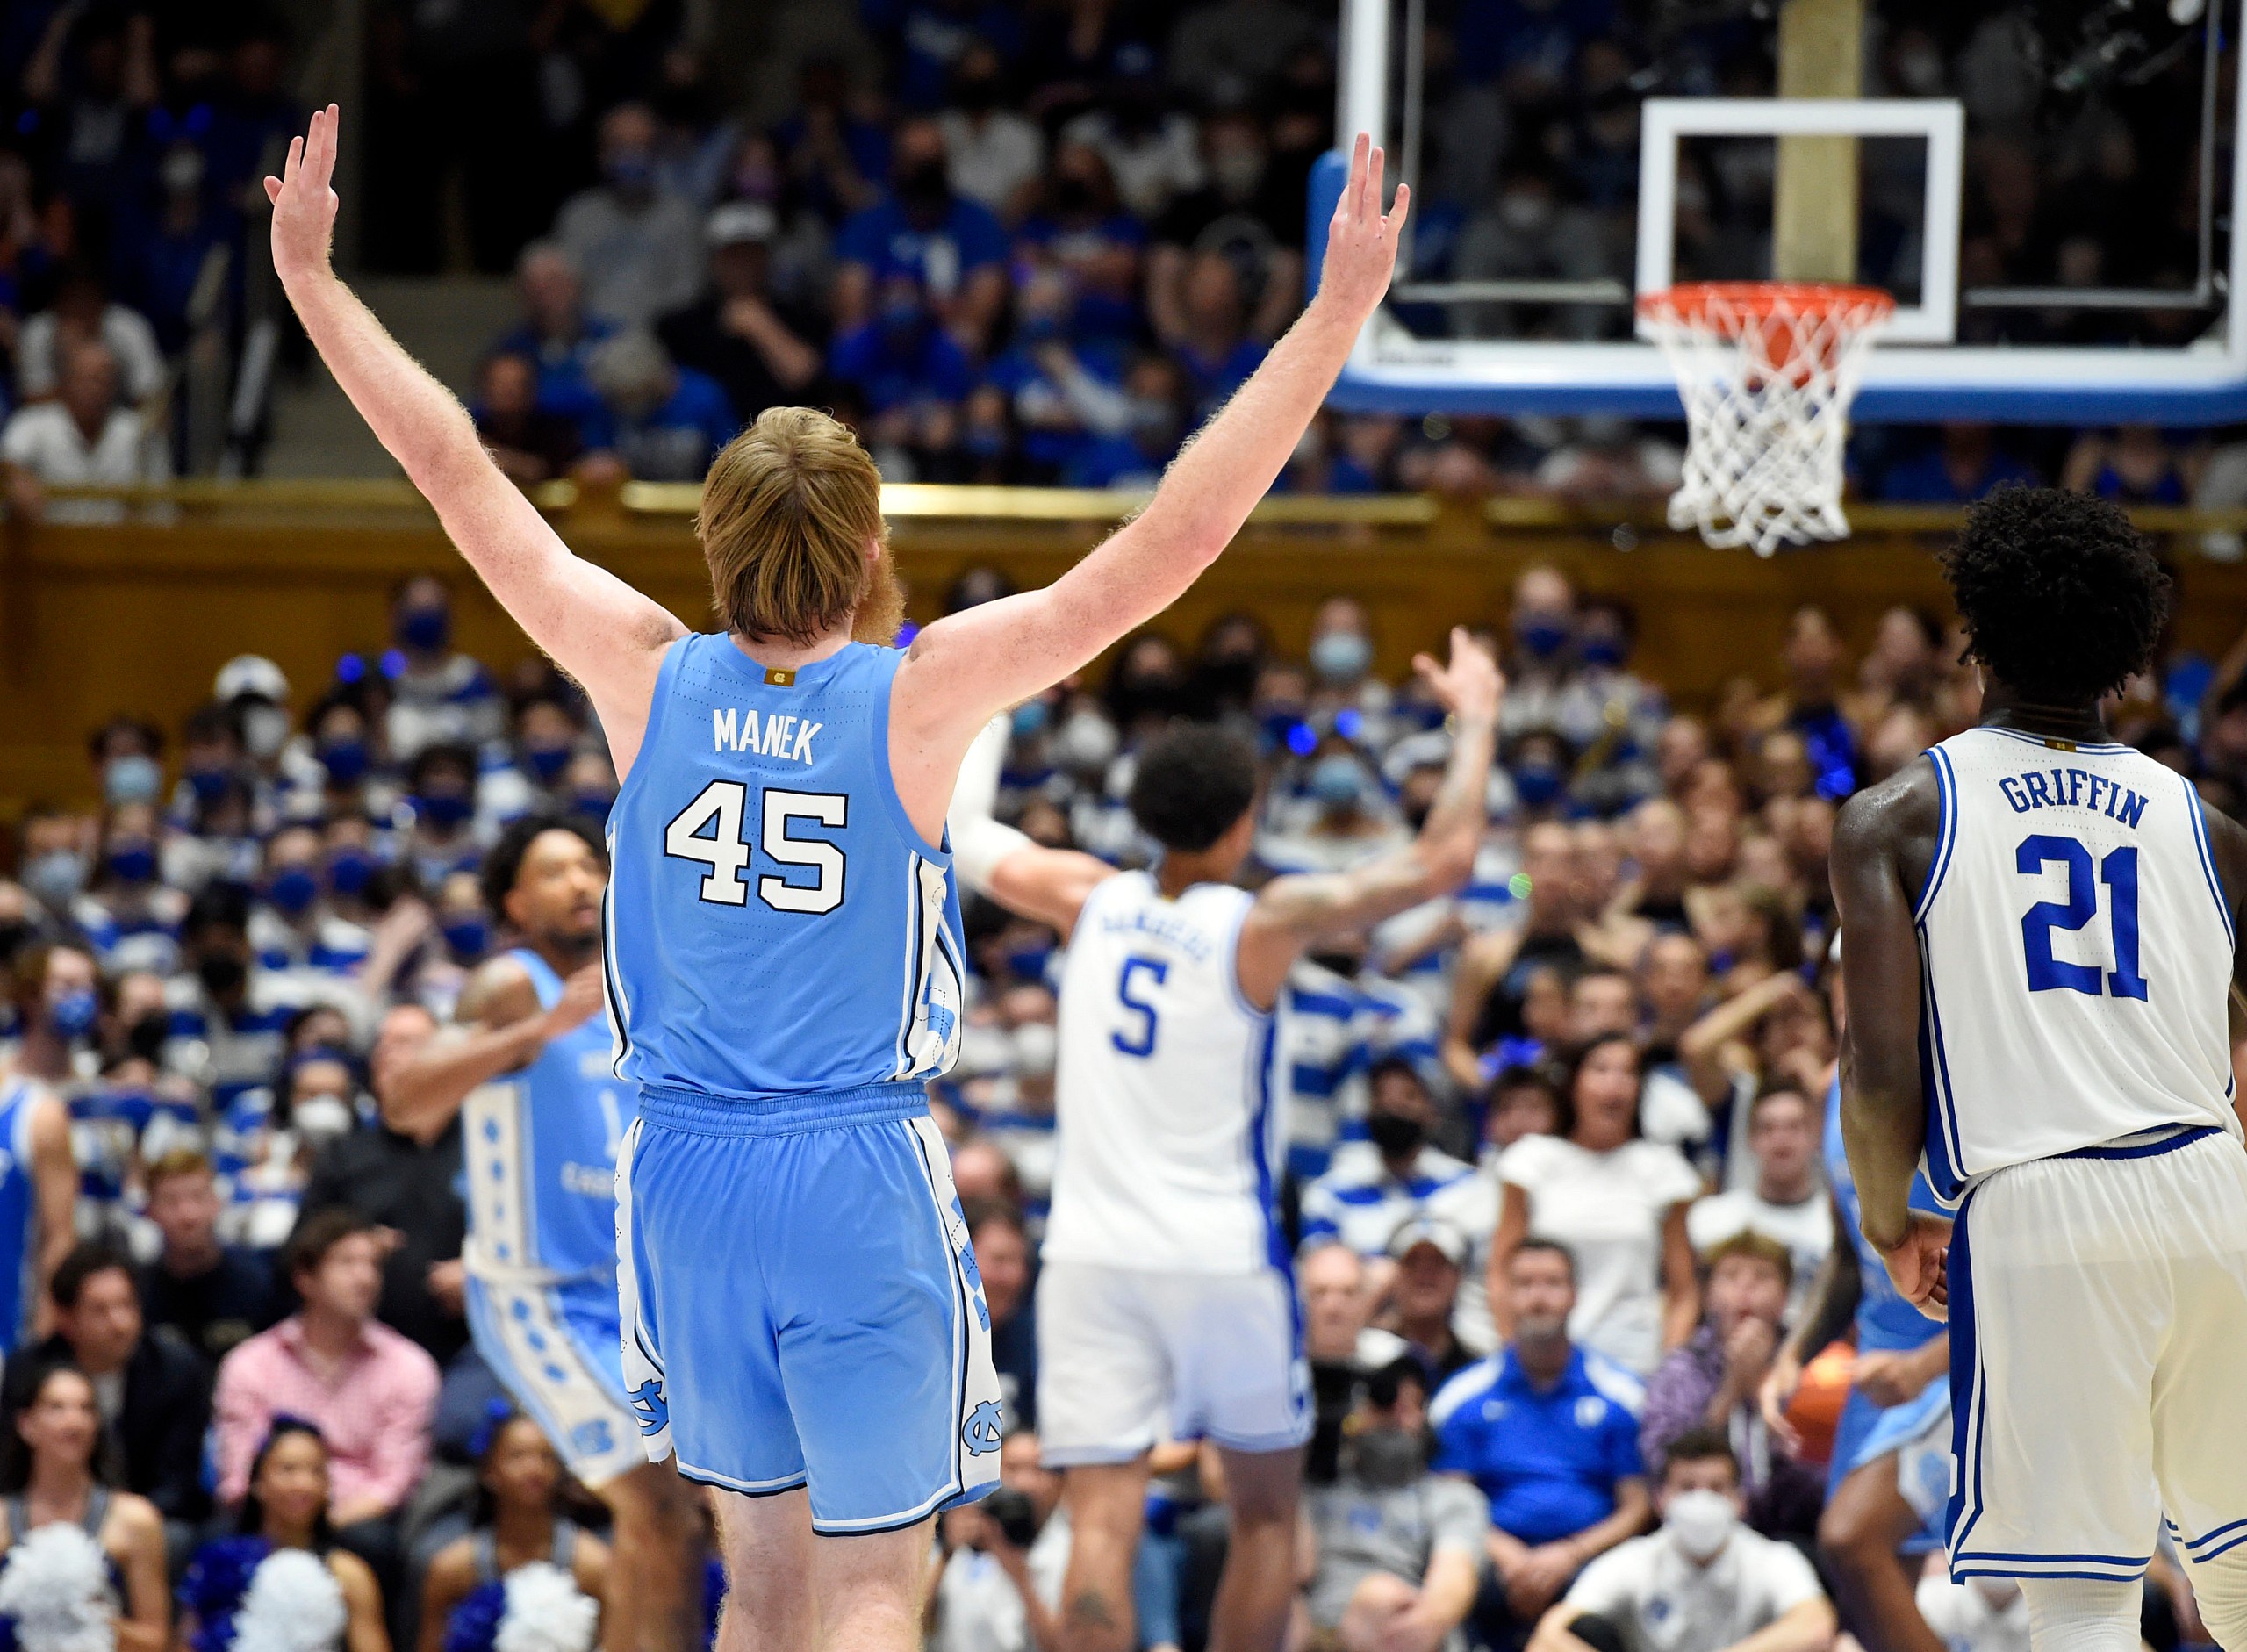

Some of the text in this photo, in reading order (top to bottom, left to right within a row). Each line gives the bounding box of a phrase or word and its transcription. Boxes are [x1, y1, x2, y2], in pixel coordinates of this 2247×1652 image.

[713, 707, 823, 765] MANEK
[664, 779, 849, 916] 45
[1999, 768, 2150, 830] GRIFFIN
[2015, 834, 2149, 1002] 21
[1111, 955, 1168, 1057] 5
